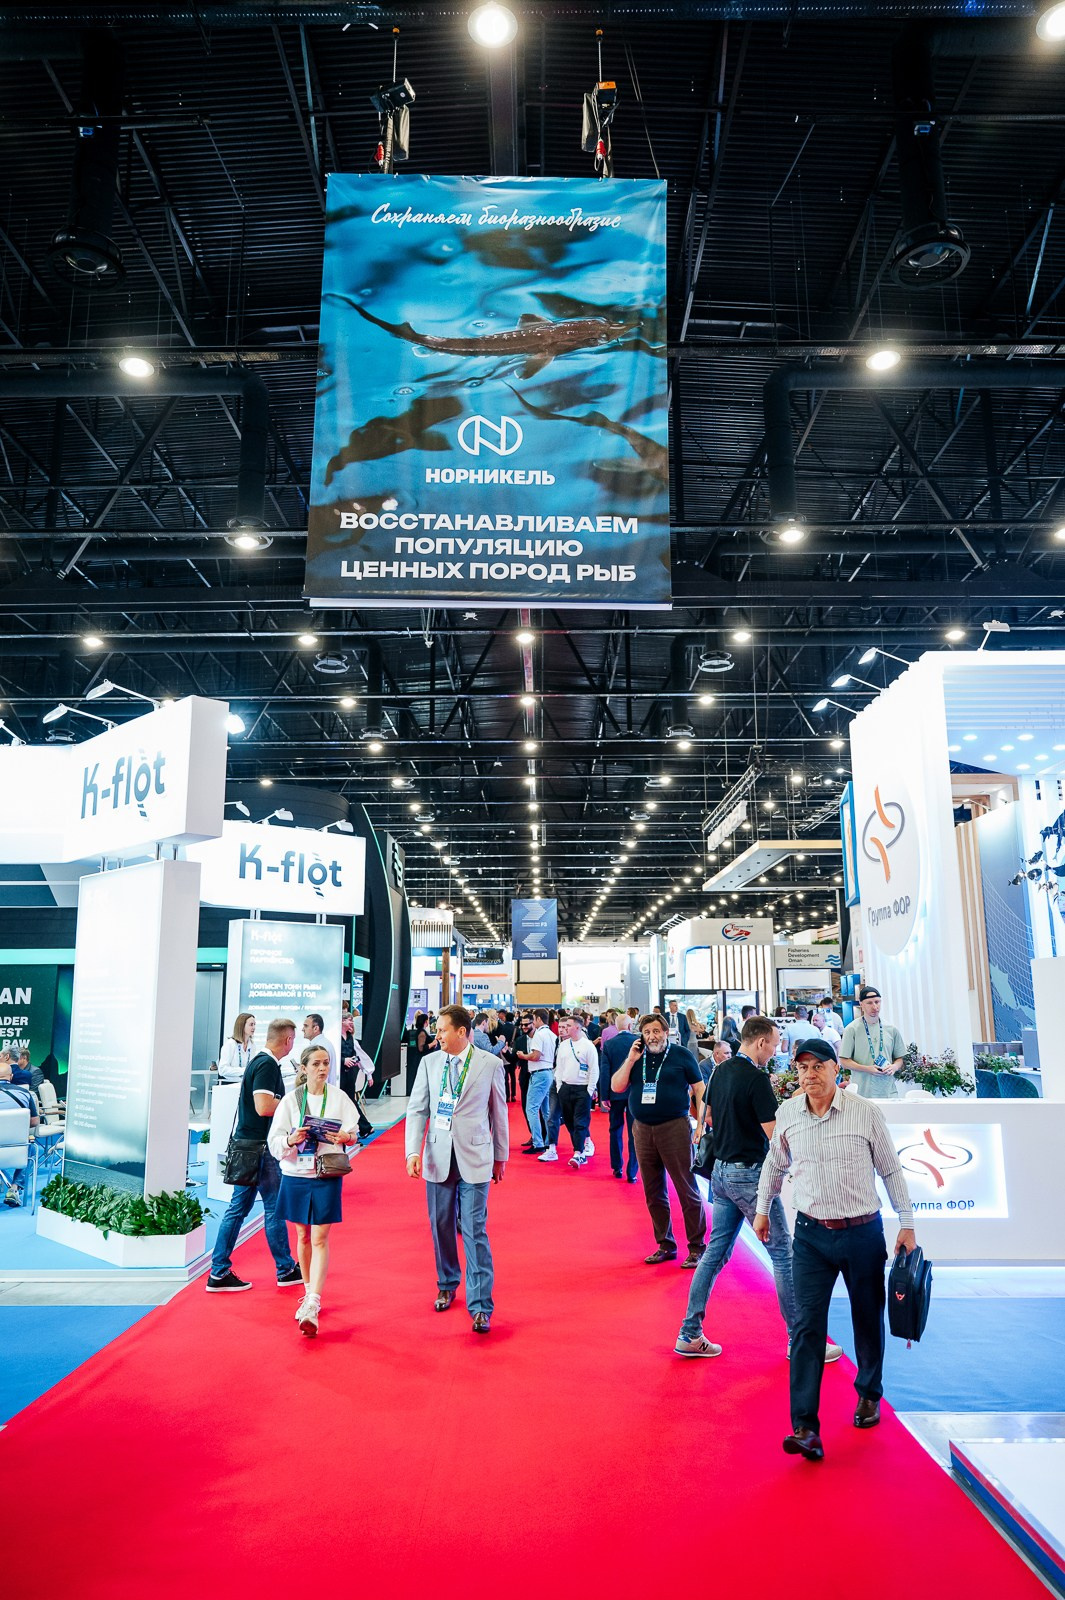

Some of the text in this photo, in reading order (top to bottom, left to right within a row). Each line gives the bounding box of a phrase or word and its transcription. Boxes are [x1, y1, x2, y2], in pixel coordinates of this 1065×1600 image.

[371, 202, 622, 232] Сохраняем биоразнообразие
[425, 468, 556, 486] НОРНИКЕЛЬ
[340, 512, 638, 534] ВОССТАНАВЛИВАЕМ
[395, 537, 583, 558] ПОПУЛЯЦИЮ
[340, 560, 636, 583] ЦЕННЫХ ПОРОД РЫБ
[868, 895, 911, 927] Группа ФОР
[2, 1039, 31, 1048] RAW
[911, 1199, 975, 1212] уппа ФОР
